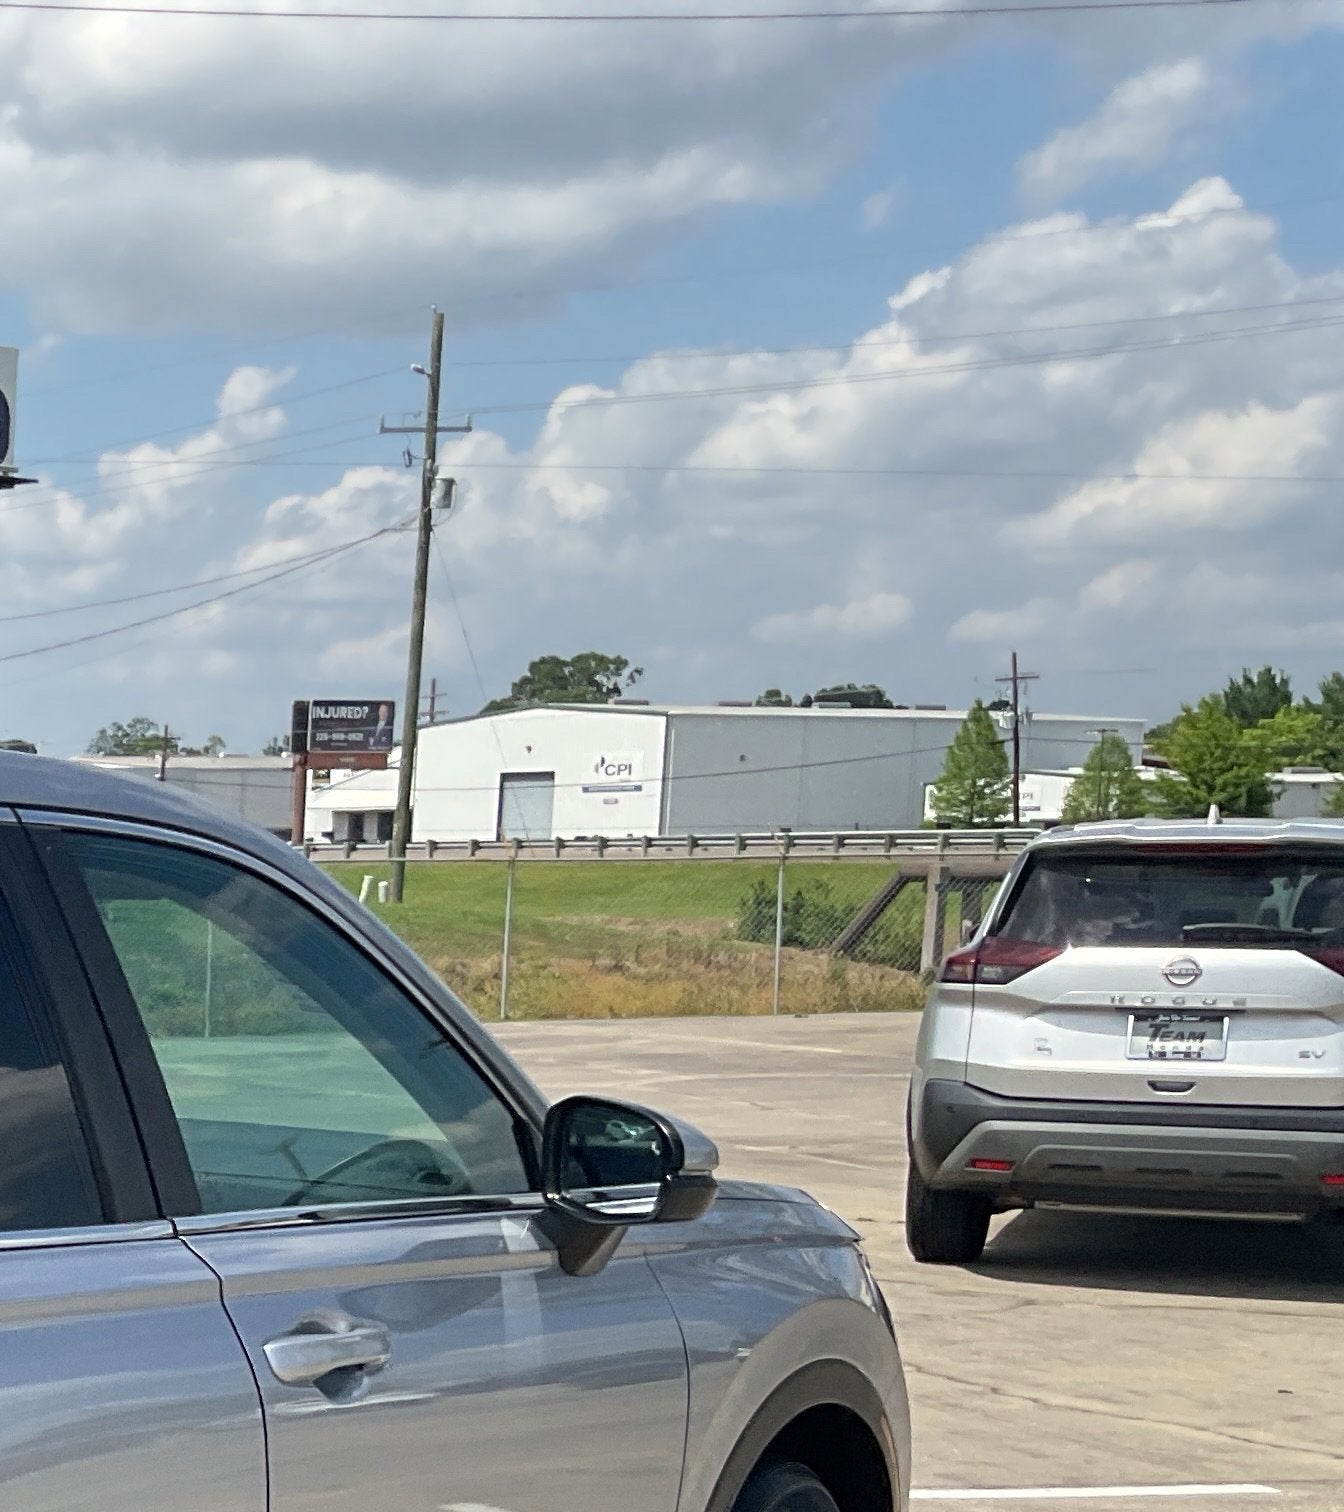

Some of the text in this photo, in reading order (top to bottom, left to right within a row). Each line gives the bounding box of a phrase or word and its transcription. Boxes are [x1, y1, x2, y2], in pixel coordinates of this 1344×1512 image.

[312, 706, 369, 719] INJURED?
[604, 763, 632, 776] CPI
[1148, 1023, 1206, 1043] TEAM
